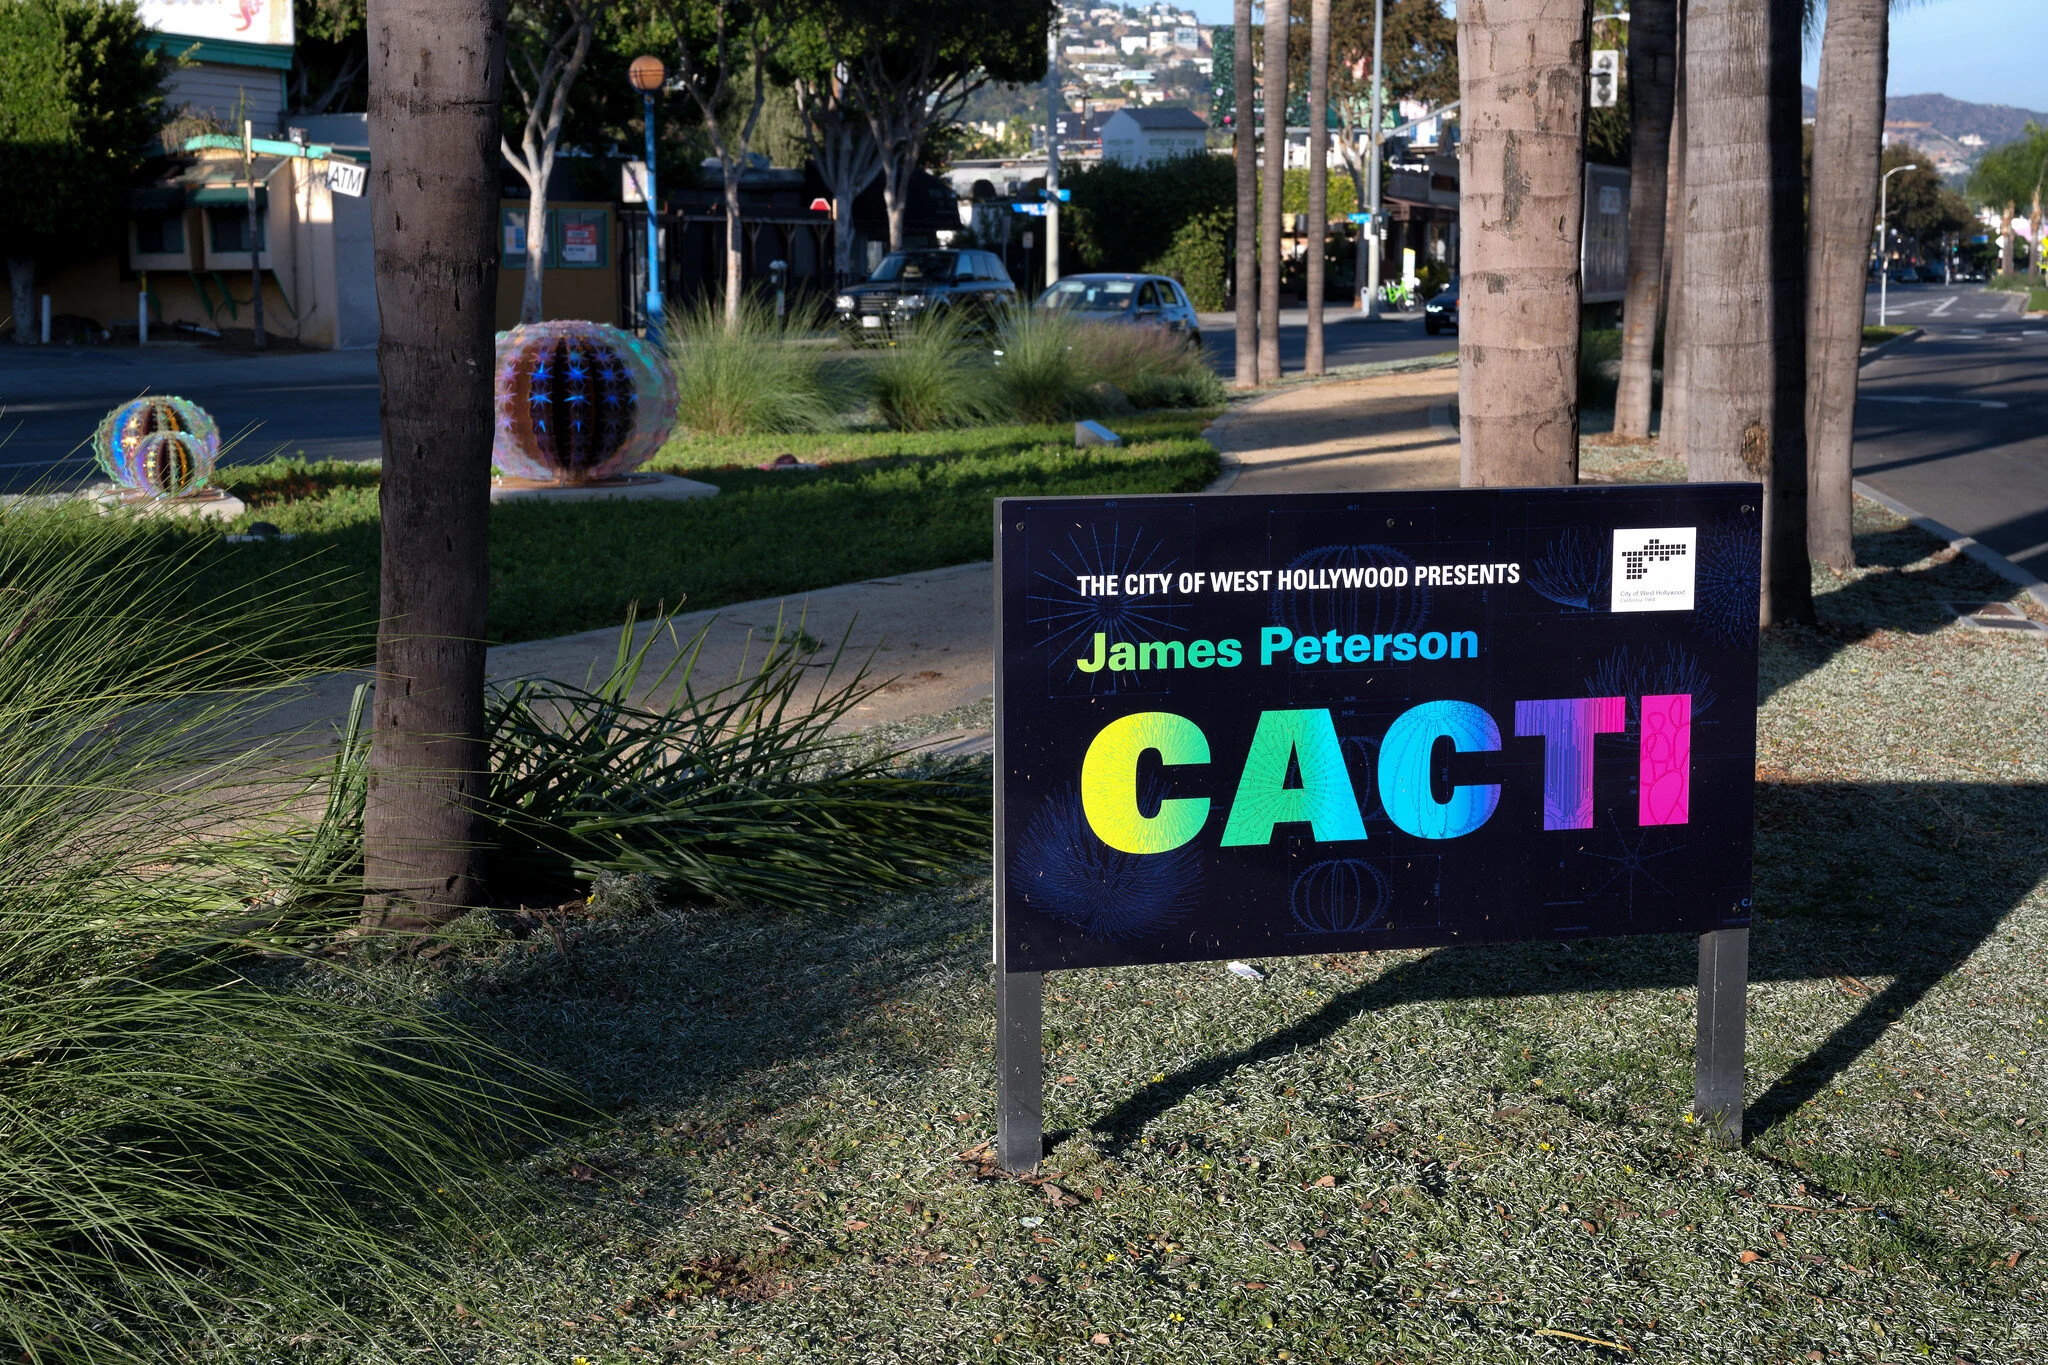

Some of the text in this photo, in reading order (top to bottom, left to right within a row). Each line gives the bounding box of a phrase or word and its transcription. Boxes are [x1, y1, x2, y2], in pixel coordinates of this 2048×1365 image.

[1149, 137, 1174, 147] empty
[329, 166, 362, 192] ATM
[1076, 562, 1521, 597] THE CITY OF WEST HOLLYWOOD PRESENTS
[1620, 590, 1631, 598] City
[1656, 589, 1686, 597] Hollywood
[1076, 626, 1479, 673] James Peterson
[1080, 693, 1692, 855] CACTI
